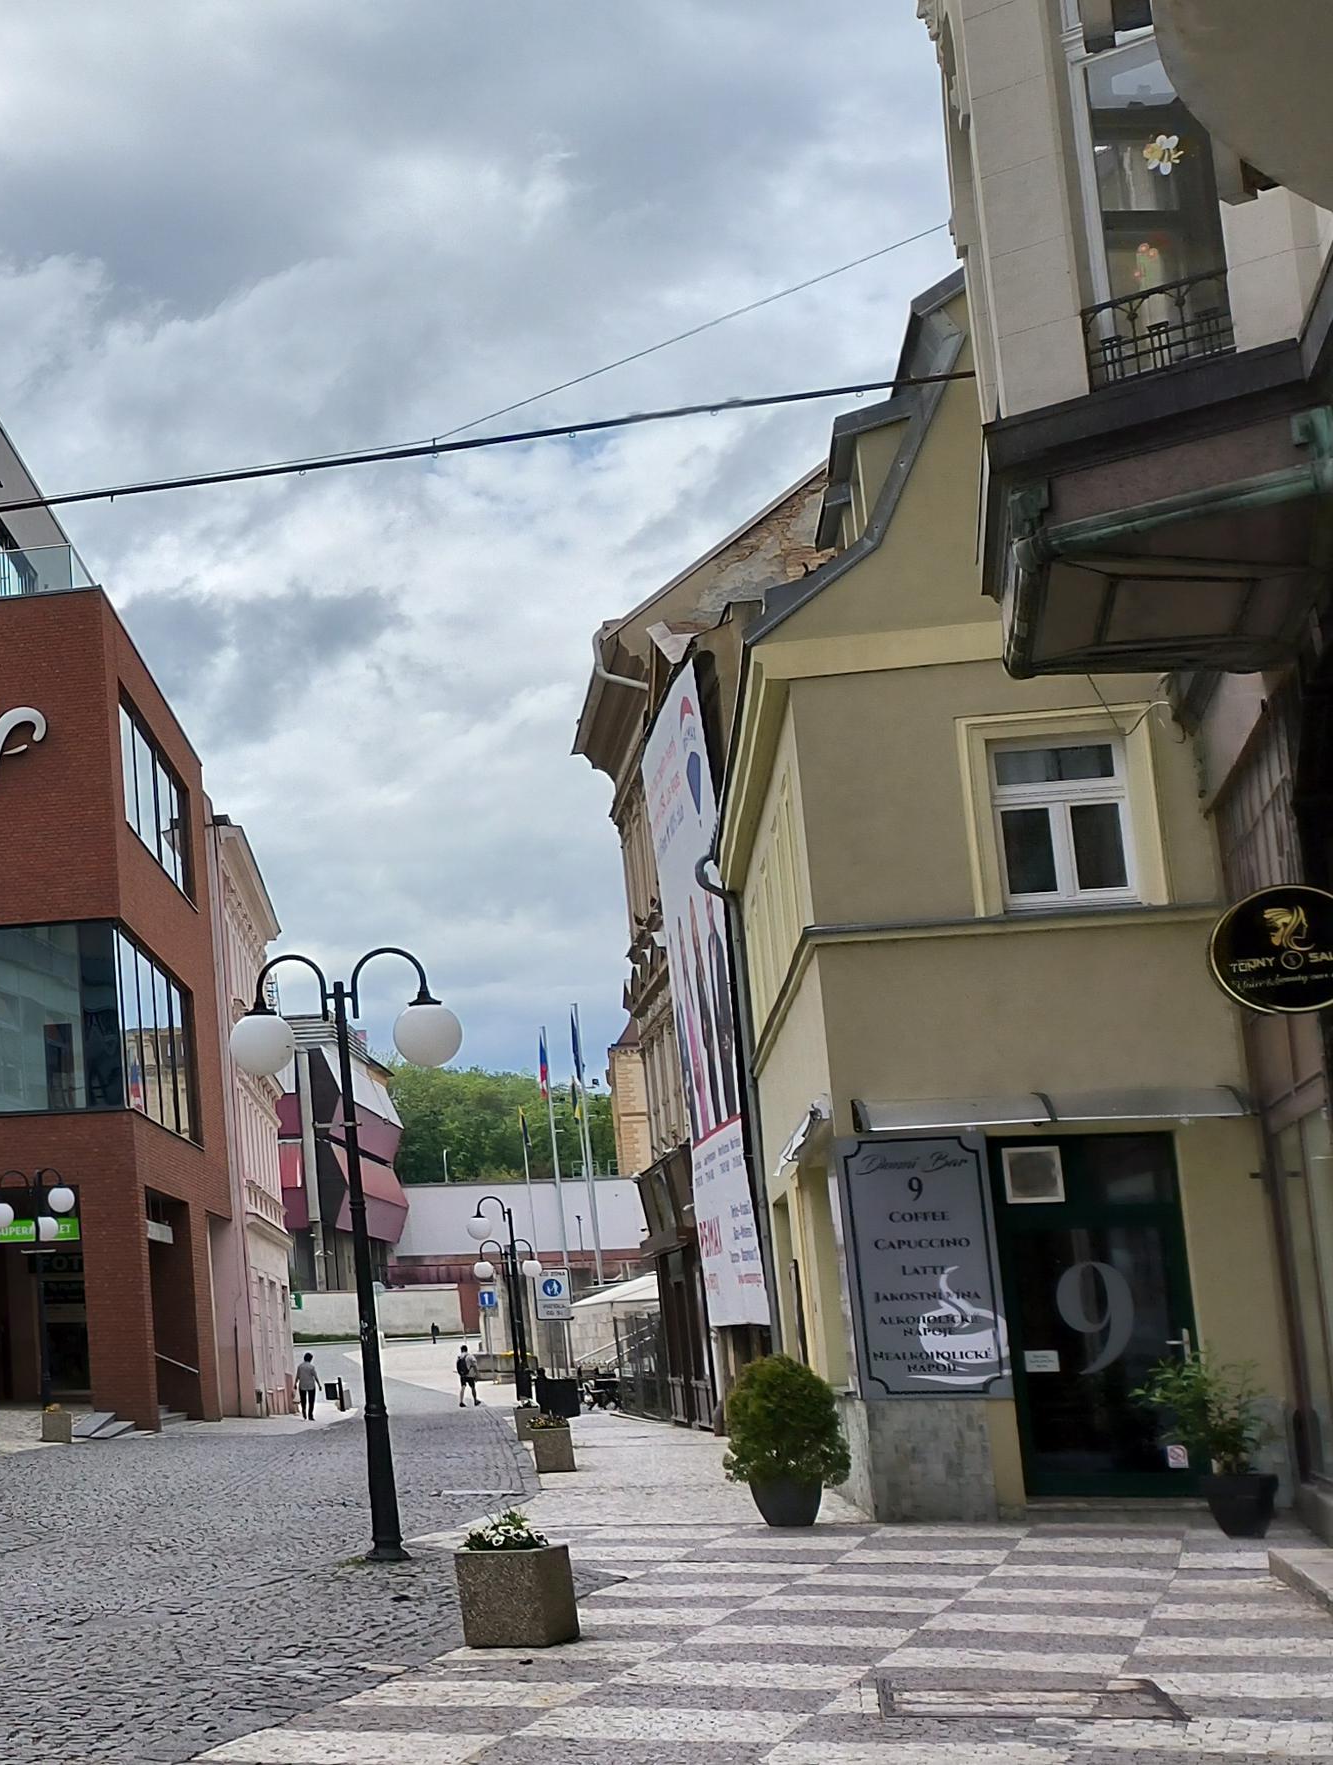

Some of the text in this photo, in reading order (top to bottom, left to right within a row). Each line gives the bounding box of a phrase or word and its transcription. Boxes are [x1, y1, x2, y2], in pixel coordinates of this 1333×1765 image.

[921, 1152, 968, 1173] Bar
[907, 1176, 924, 1202] 9
[889, 1211, 952, 1223] COFFEE
[874, 1237, 971, 1250] CAPUCCINO
[1056, 1261, 1133, 1376] 9
